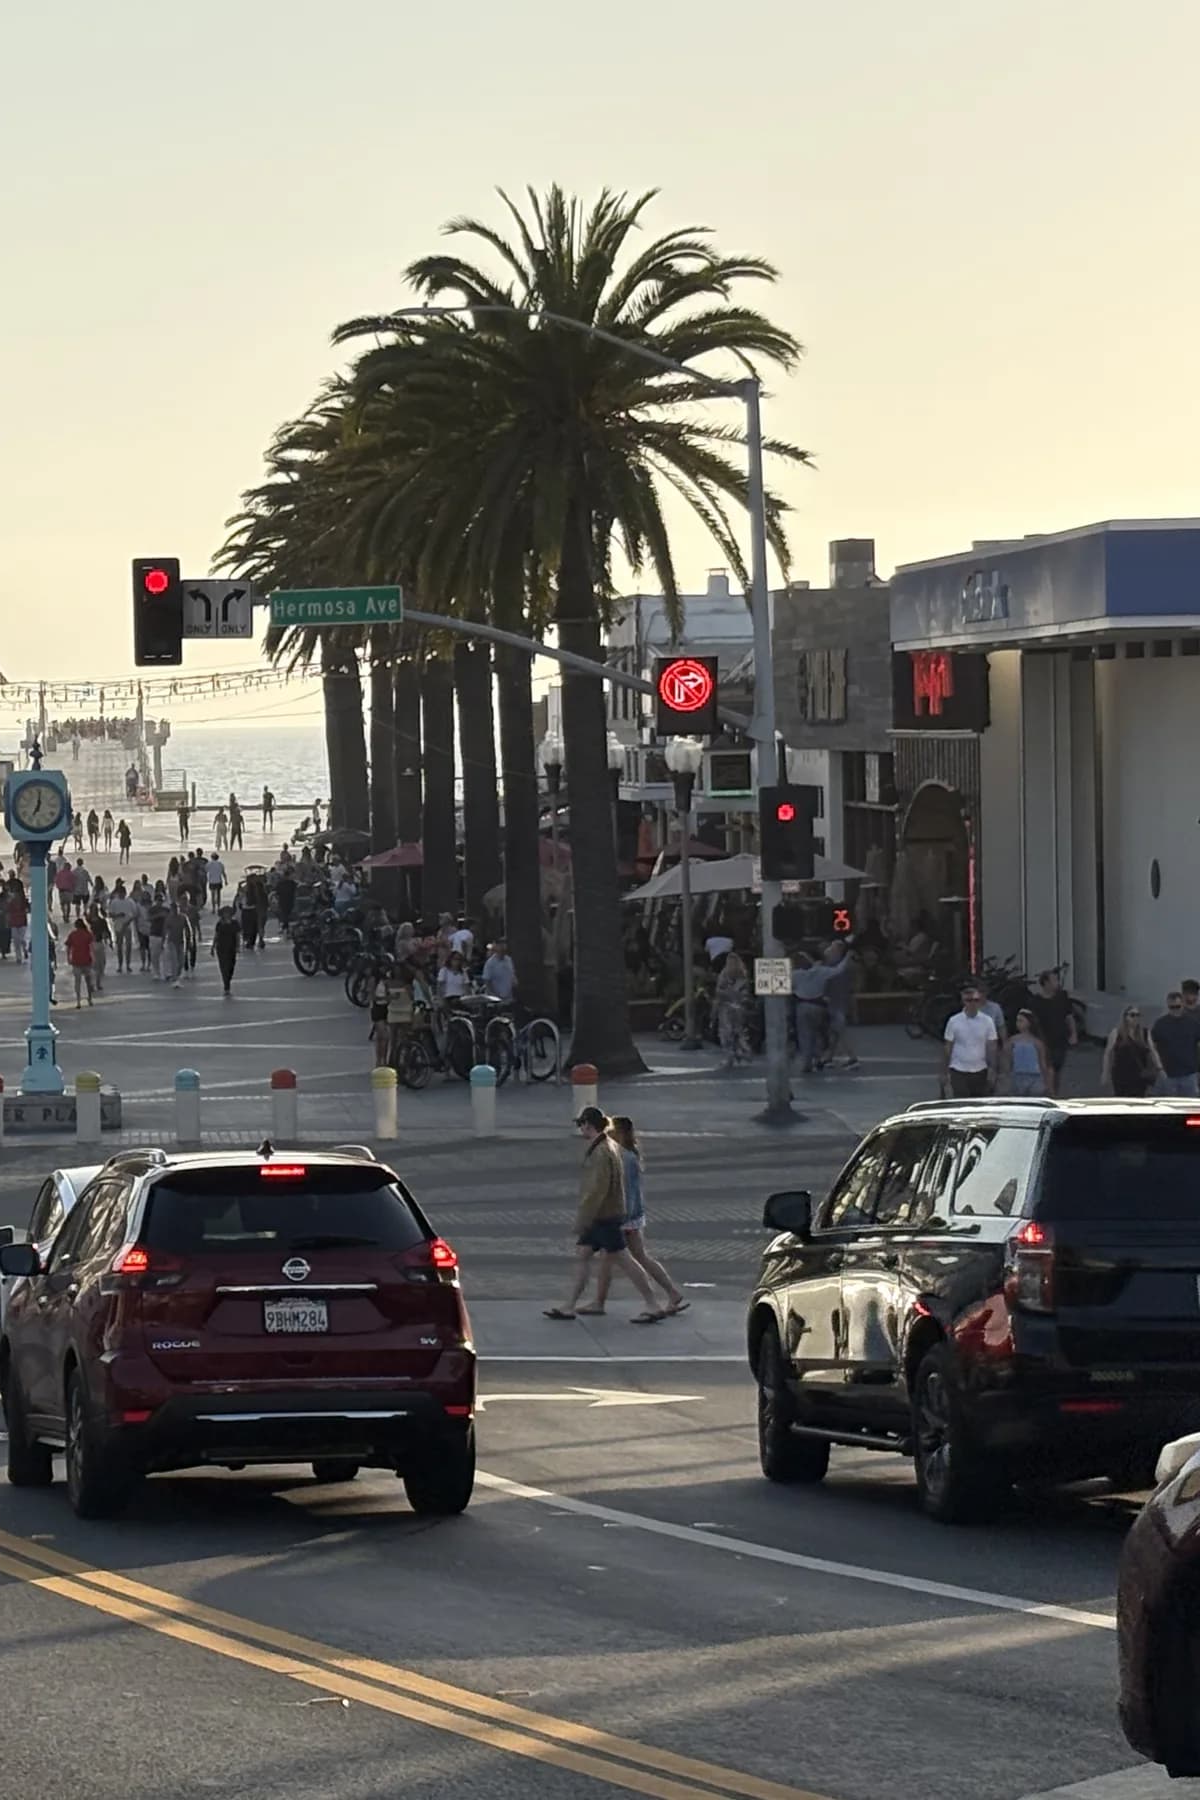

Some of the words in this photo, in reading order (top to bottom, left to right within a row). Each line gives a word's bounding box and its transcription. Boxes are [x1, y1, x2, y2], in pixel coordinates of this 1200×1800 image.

[273, 600, 356, 617] Hermosa
[366, 596, 398, 614] Ave
[186, 624, 211, 635] ONLY
[221, 623, 247, 634] ONLY
[266, 1310, 327, 1328] 9BHM284
